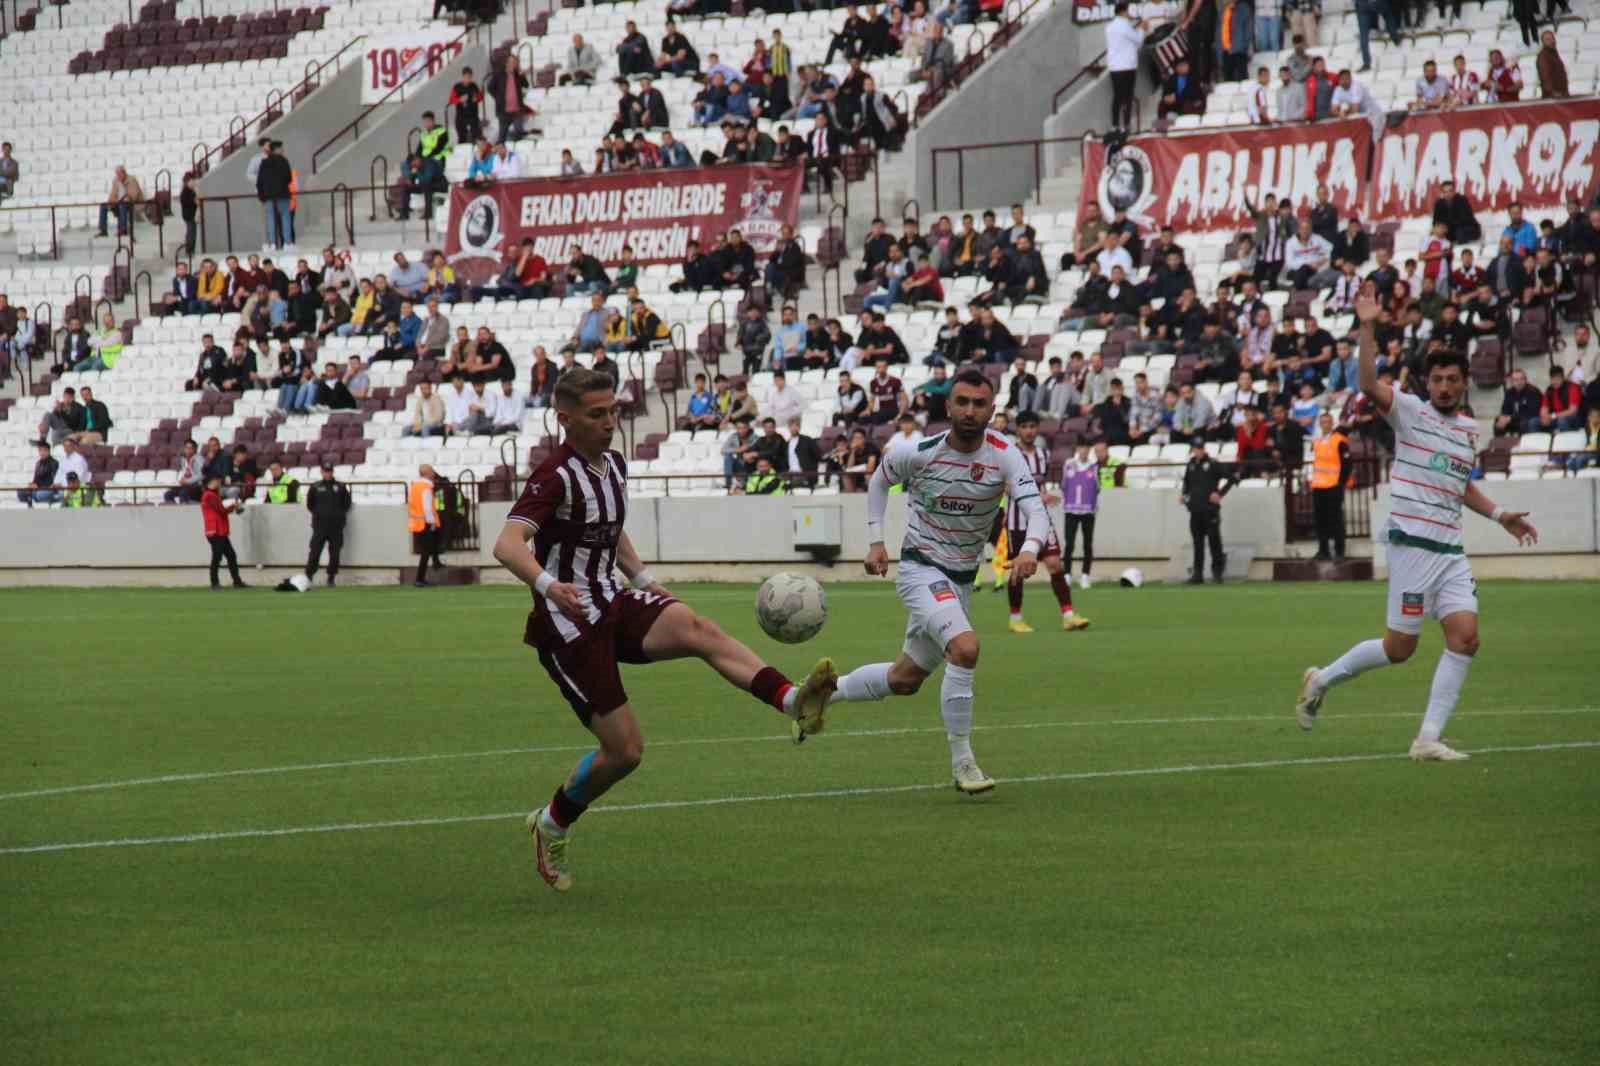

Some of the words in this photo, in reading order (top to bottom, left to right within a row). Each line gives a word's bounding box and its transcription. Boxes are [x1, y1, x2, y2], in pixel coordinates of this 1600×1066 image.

[368, 48, 399, 89] 19
[1165, 138, 1358, 226] ABLUKA
[1376, 119, 1600, 213] NARKOZ
[520, 193, 574, 227] EFKAR
[574, 189, 623, 223] DOLU
[622, 181, 728, 225] ŞEHİRLERDE
[940, 498, 975, 513] bitay
